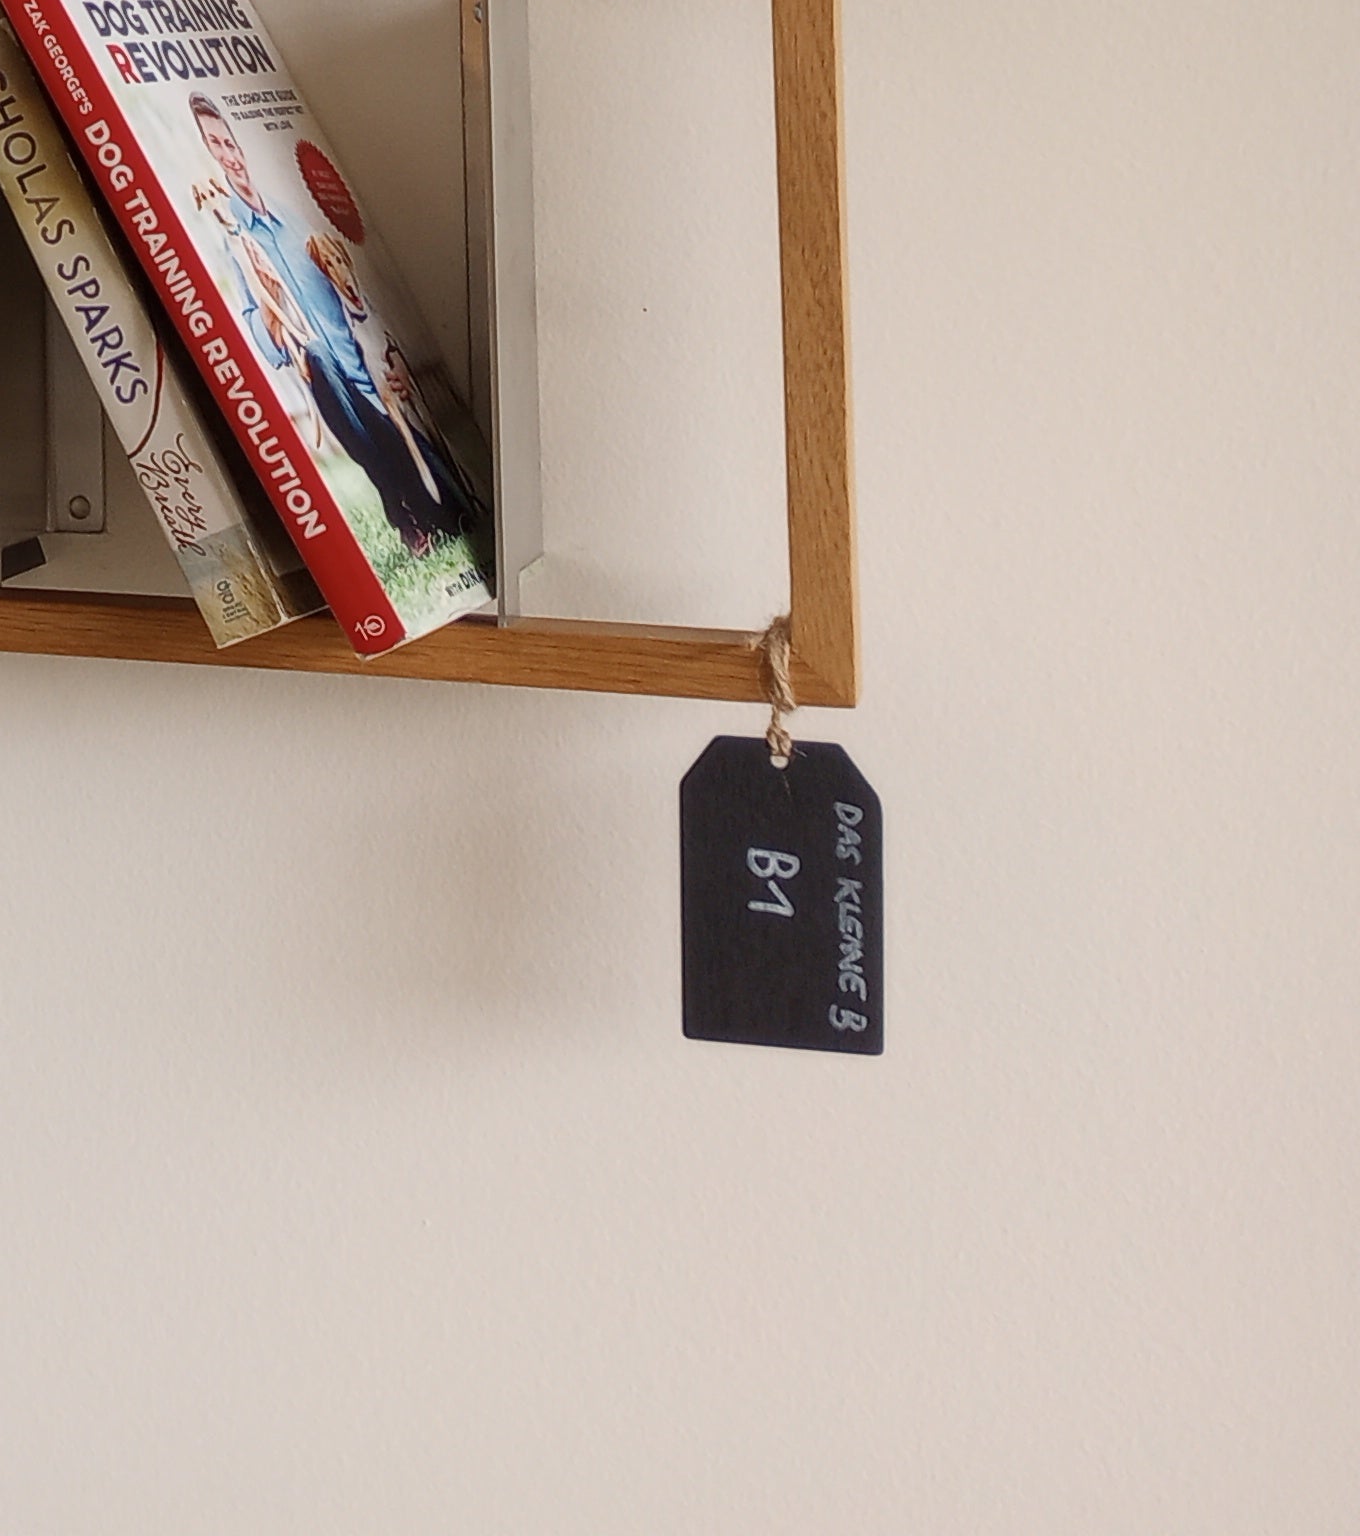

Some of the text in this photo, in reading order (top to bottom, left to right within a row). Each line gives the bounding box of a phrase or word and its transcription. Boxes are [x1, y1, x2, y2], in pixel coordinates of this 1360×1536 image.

[82, 0, 150, 37] DOG
[106, 35, 278, 84] REVOLUTION
[42, 33, 94, 115] GEORGE'S
[83, 118, 135, 192] DOG
[123, 189, 216, 339] TRAINING
[201, 337, 327, 541] REVOLUTION
[56, 251, 150, 405] SPARKS
[833, 801, 864, 865] DAS
[746, 847, 802, 918] B1
[829, 1003, 868, 1032] B
